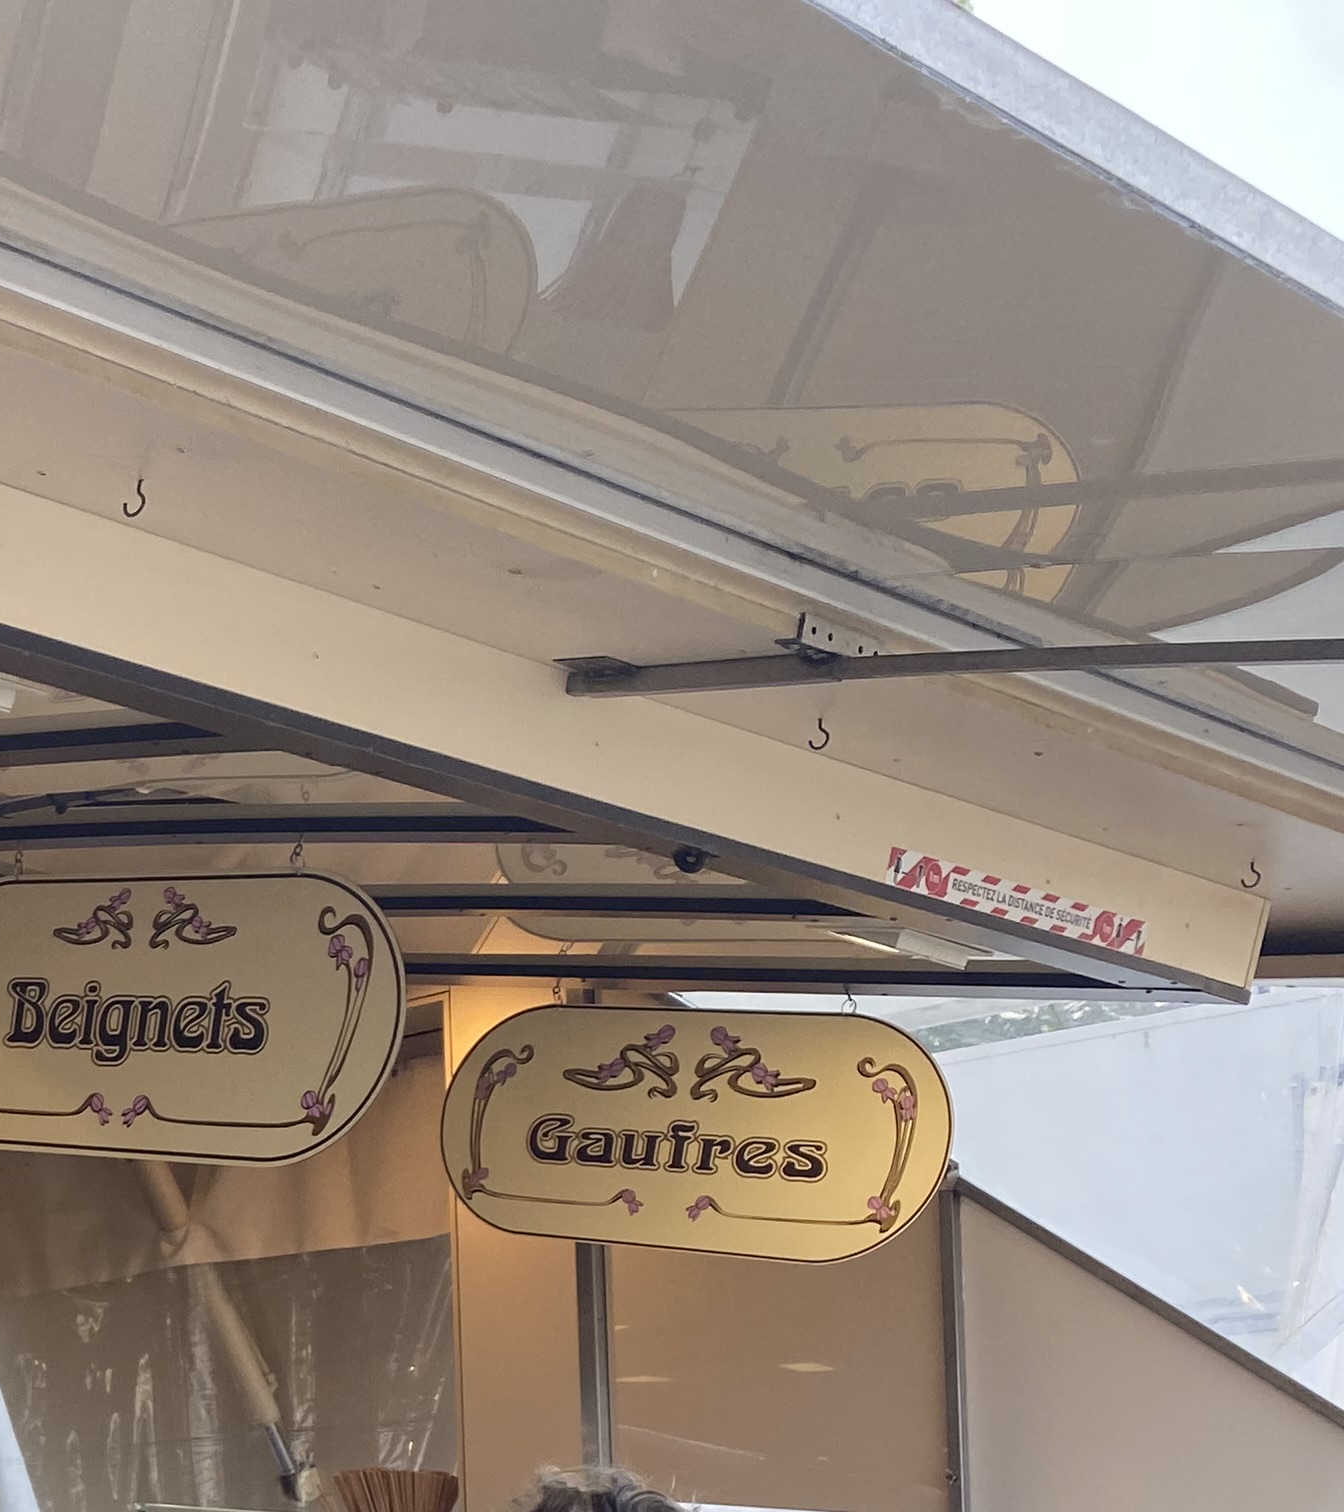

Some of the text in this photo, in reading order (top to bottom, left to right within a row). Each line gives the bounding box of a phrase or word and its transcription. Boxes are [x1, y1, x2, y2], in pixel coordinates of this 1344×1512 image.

[952, 878, 996, 901] RESPECTEZ
[996, 893, 1007, 905] LA
[1007, 895, 1044, 916] DISTANCE
[1044, 906, 1055, 919] DE
[1056, 907, 1092, 929] SÉCURITÉ
[4, 977, 271, 1066] Beignets
[525, 1113, 829, 1183] Gaufres
